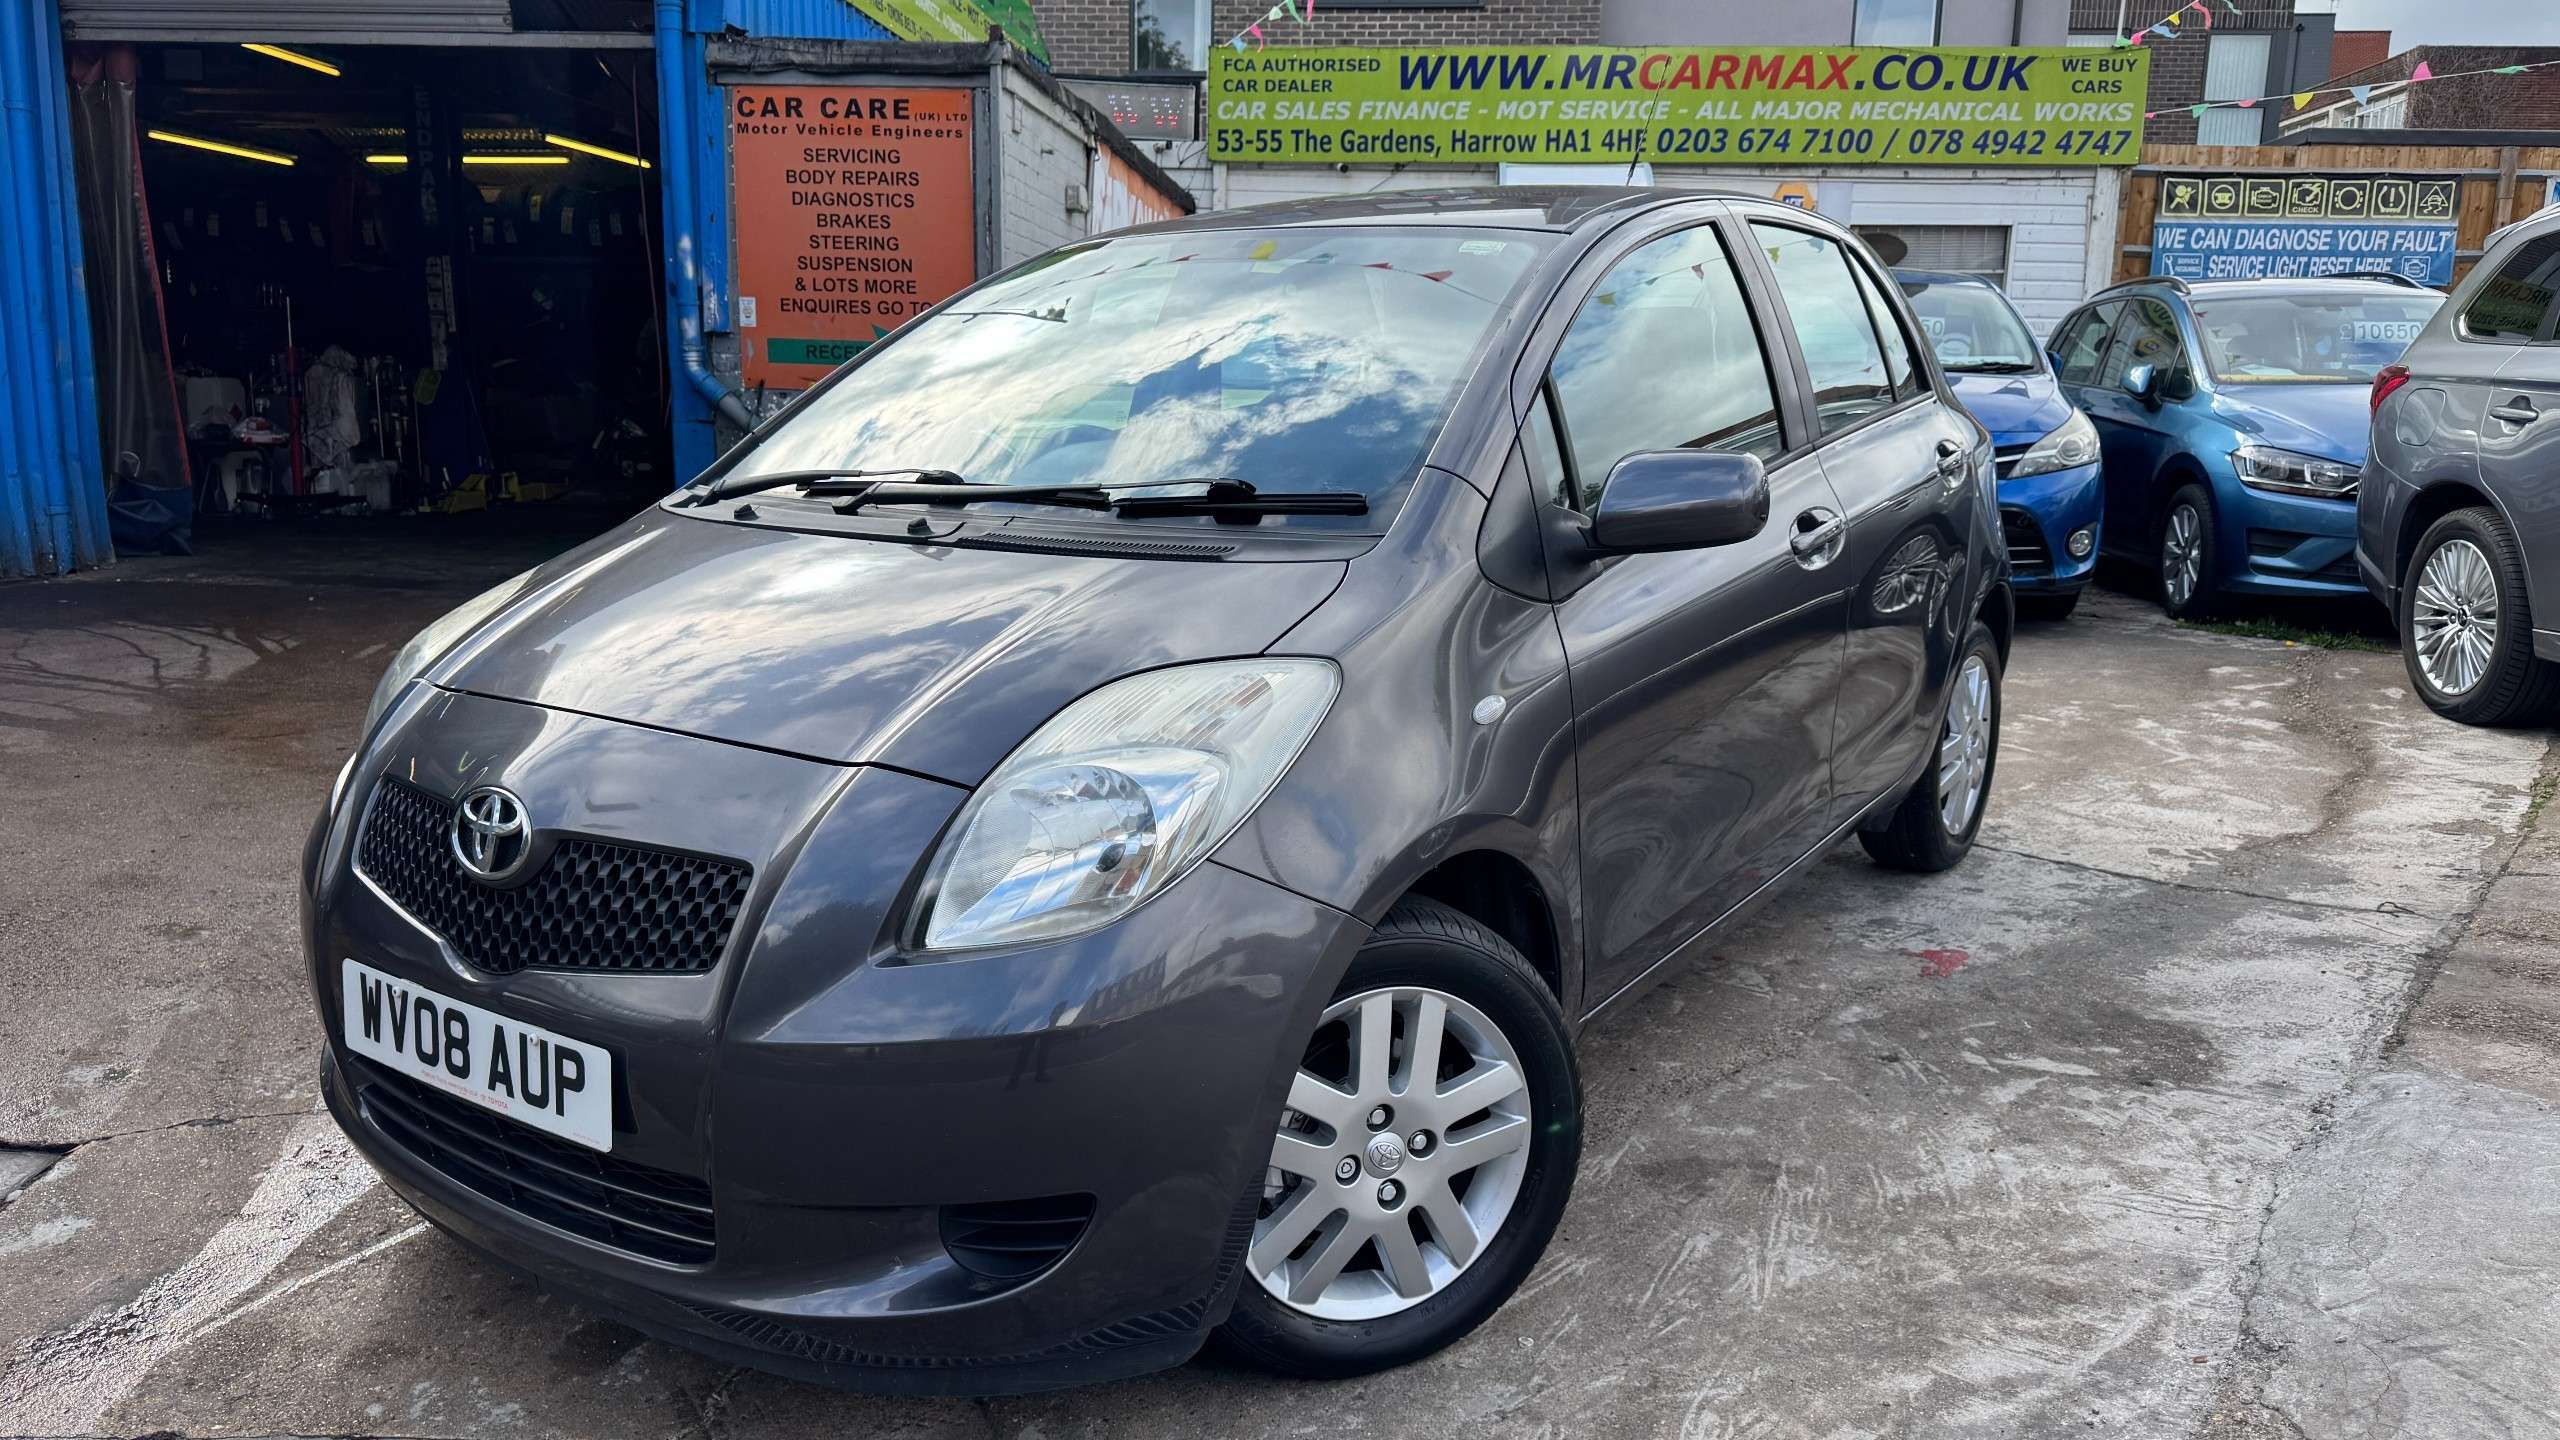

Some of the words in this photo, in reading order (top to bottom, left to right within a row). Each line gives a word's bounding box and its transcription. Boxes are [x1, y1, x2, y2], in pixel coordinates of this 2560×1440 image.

[1223, 58, 1257, 73] FCA
[1263, 58, 1381, 73] AUTHORISED
[1400, 54, 2039, 92] WWW.MRCARMAX.CO.UK
[2062, 58, 2091, 73] WE
[2098, 58, 2138, 73] BUY
[1223, 79, 1261, 93] CAR
[1265, 79, 1333, 93] DEALER
[2071, 79, 2122, 94] CARS
[737, 96, 803, 118] CAR
[820, 98, 910, 120] CARE
[914, 112, 941, 122] (UK)
[945, 112, 968, 122] LTD
[1217, 101, 1268, 121] CAR
[1272, 101, 1355, 120] SALES
[1359, 101, 1471, 120] FINANCE
[1495, 102, 1554, 120] MOT
[1558, 101, 1671, 120] SERVICE
[1695, 102, 1742, 120] ALL
[1751, 102, 1841, 121] MAJOR
[1849, 102, 2023, 121] MECHANICAL
[2033, 102, 2134, 121] WORKS
[737, 123, 787, 135] Motor
[796, 123, 863, 136] Vehicle
[872, 125, 963, 140] Engineers
[1216, 129, 1283, 153] 53-55
[1291, 129, 1332, 153] The
[1340, 129, 1441, 158] Gardens,
[1450, 129, 1538, 153] Harrow
[1545, 129, 1591, 153] HA1
[1601, 129, 1647, 153] 4HE
[1657, 128, 1728, 153] 0203
[1737, 129, 1791, 153] 674
[1801, 129, 1874, 153] 7100
[1908, 130, 1963, 154] 078
[1972, 130, 2046, 154] 4942
[2054, 131, 2132, 155] 4747
[803, 148, 901, 164] SERVICING
[785, 170, 836, 185] BODY
[842, 171, 920, 187] REPAIRS
[791, 191, 915, 208] DIAGNOSTICS
[816, 214, 892, 229] BRAKES
[809, 235, 899, 251] STEERING
[2158, 228, 2187, 249] WE
[2191, 228, 2232, 250] CAN
[2234, 229, 2335, 251] DIAGNOSE
[2337, 230, 2390, 252] YOUR
[2392, 231, 2448, 252] FAULT
[797, 256, 913, 273] SUSPENSION
[2208, 255, 2266, 279] SERVICE
[2266, 256, 2310, 279] LIGHT
[2308, 256, 2354, 277] RESET
[2355, 257, 2393, 274] HERE
[795, 277, 807, 292] &
[812, 278, 859, 293] LOTS
[864, 279, 917, 295] MORE
[780, 298, 871, 316] ENQUIRES
[877, 300, 904, 316] GO
[909, 301, 933, 316] TO
[360, 972, 471, 1080] WV08
[487, 1024, 586, 1117] AUP
